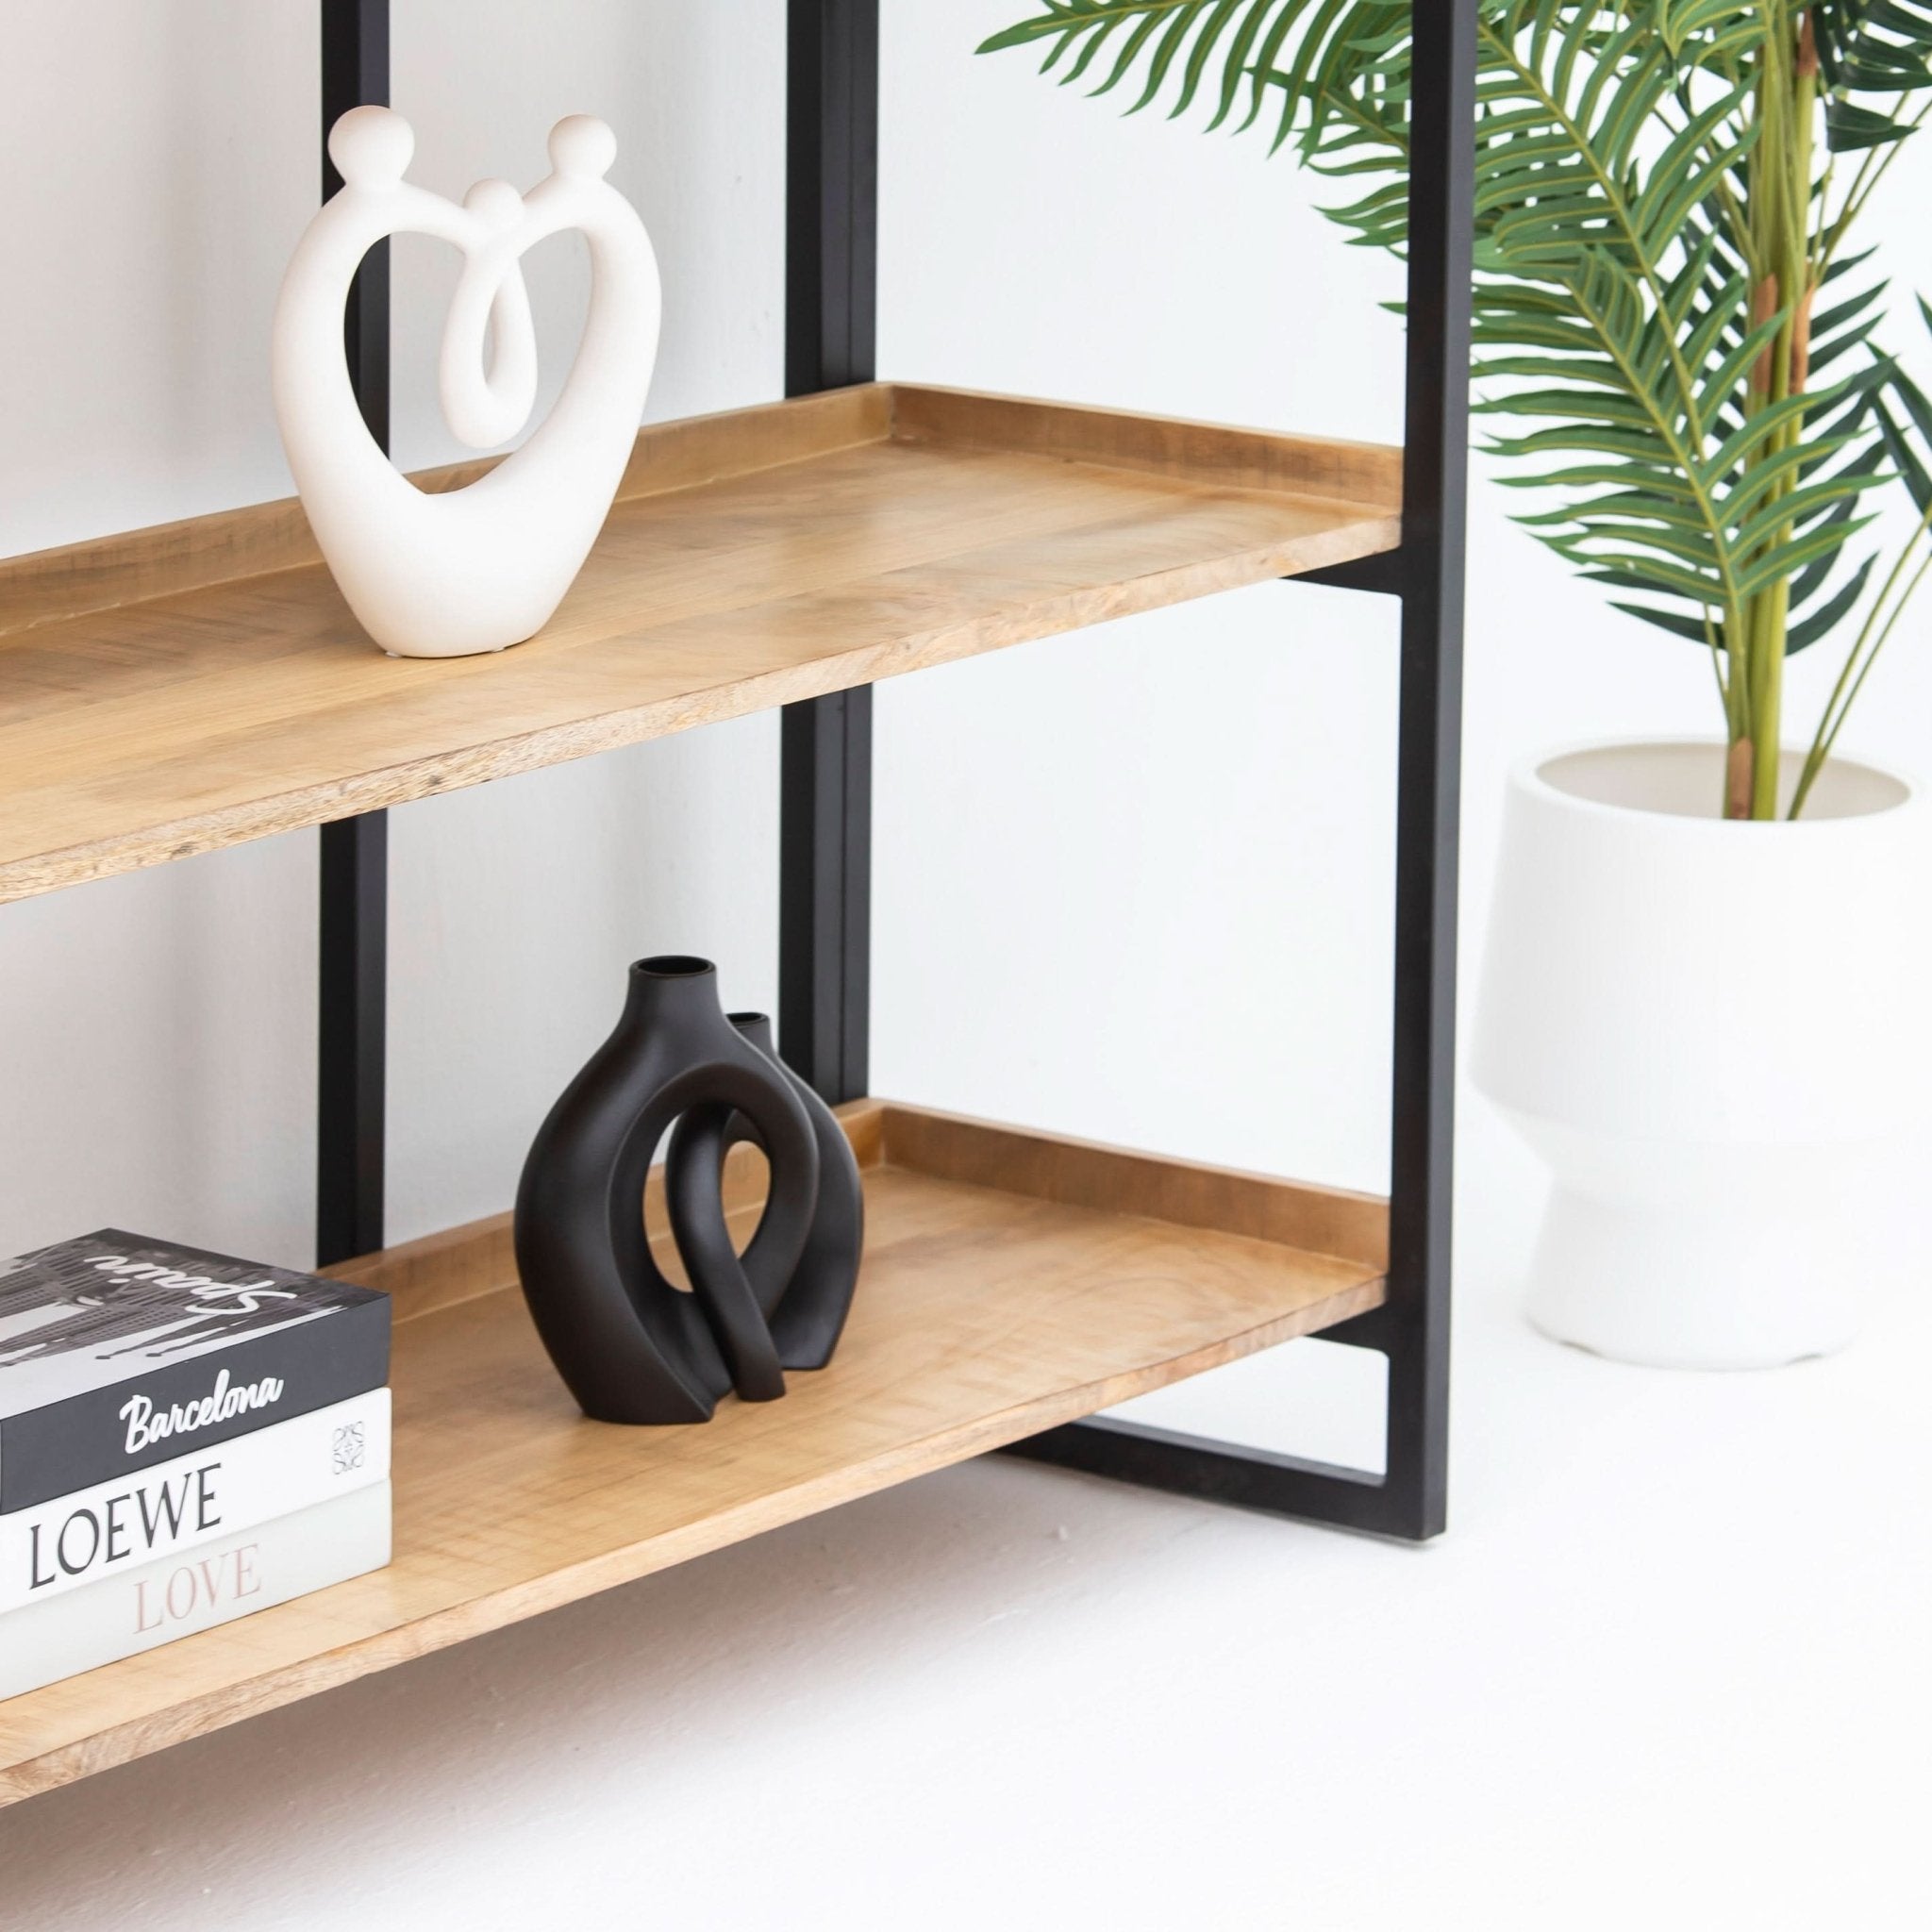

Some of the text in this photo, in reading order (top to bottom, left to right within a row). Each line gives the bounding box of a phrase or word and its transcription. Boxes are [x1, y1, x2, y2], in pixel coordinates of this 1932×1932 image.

[84, 1256, 297, 1314] Spain
[119, 1369, 283, 1454] Barcelona
[29, 1463, 221, 1590] LOEWE
[133, 1543, 261, 1634] LOVE
